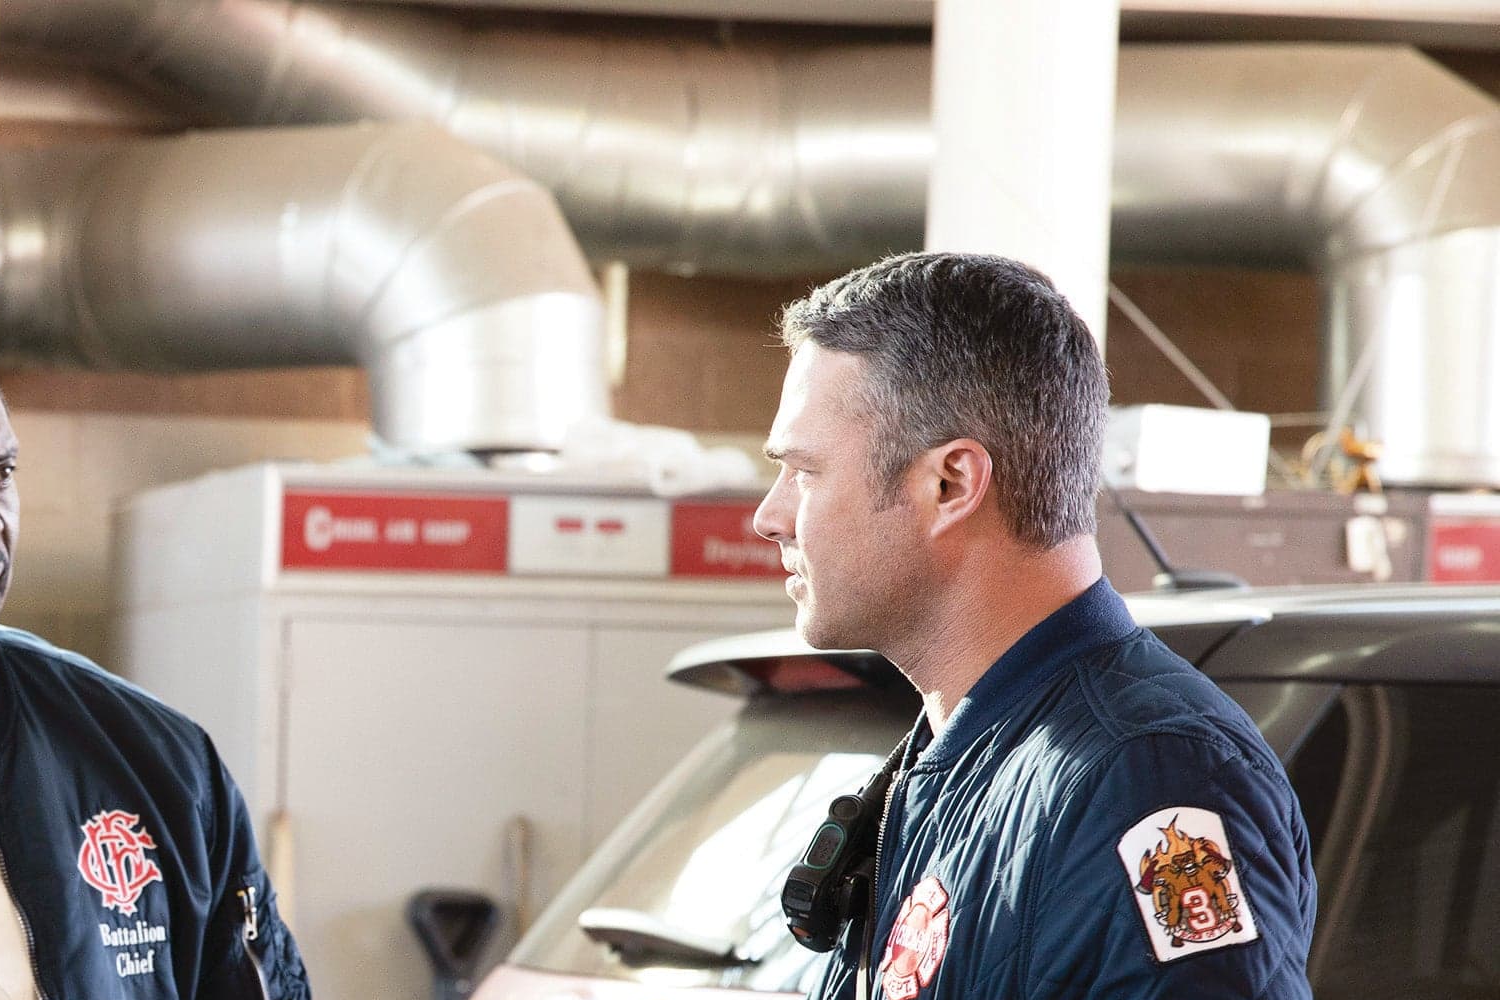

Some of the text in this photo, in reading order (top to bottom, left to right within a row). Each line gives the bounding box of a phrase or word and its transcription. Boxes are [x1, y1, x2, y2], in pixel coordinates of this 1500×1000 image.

[1182, 886, 1217, 932] 3
[99, 920, 166, 947] Battalion
[116, 950, 155, 978] Chief
